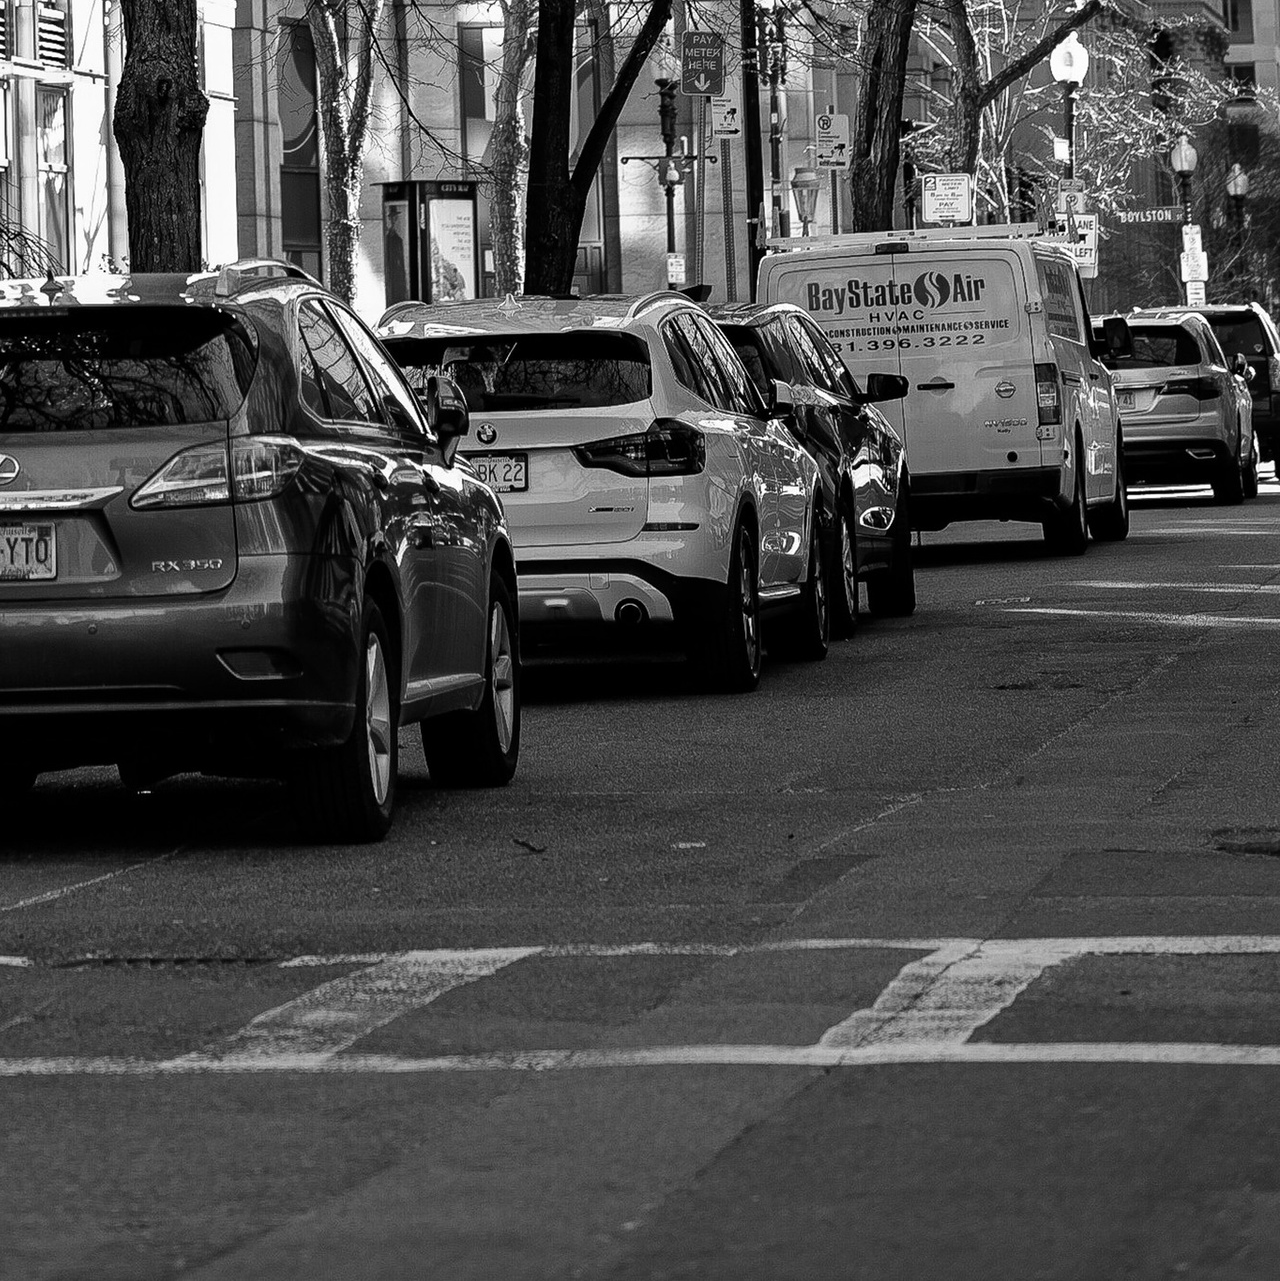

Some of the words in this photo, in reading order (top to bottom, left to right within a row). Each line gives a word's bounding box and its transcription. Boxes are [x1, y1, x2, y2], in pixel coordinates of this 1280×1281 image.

[693, 35, 714, 44] PAY
[685, 48, 720, 57] METER
[926, 178, 935, 187] 2
[1120, 210, 1172, 223] BOYLSTON
[1078, 220, 1094, 230] ANE
[1075, 248, 1093, 258] LEFT
[807, 279, 913, 315] BayState
[952, 274, 986, 303] Air
[869, 310, 924, 323] HVAC
[829, 327, 892, 339] CONSTRUCTION
[902, 322, 963, 334] MAINTENANCE
[974, 319, 1010, 330] SERVICE
[503, 463, 523, 482] 22
[151, 560, 180, 572] RX
